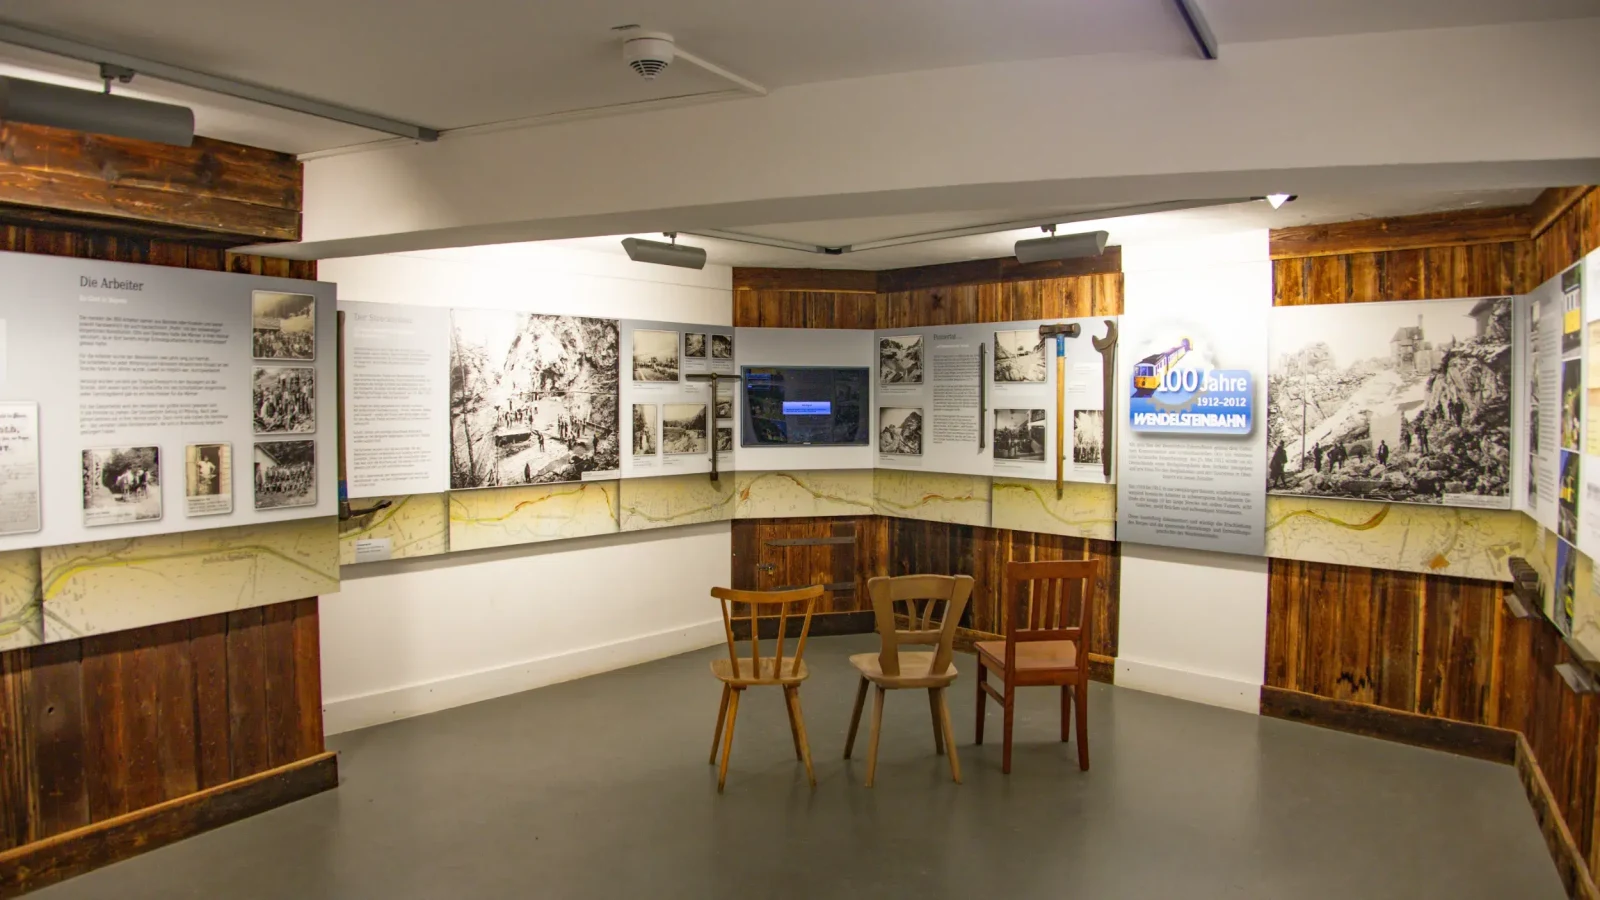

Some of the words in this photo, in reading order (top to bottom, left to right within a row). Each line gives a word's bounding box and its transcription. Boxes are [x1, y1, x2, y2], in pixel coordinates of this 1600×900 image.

[80, 276, 97, 288] Die
[101, 277, 144, 291] Arbeiter
[1158, 367, 1197, 392] 100
[1200, 367, 1247, 392] Jahre
[1197, 397, 1246, 407] 1912-2012
[1134, 412, 1246, 428] WENDELSTEINBAHN
